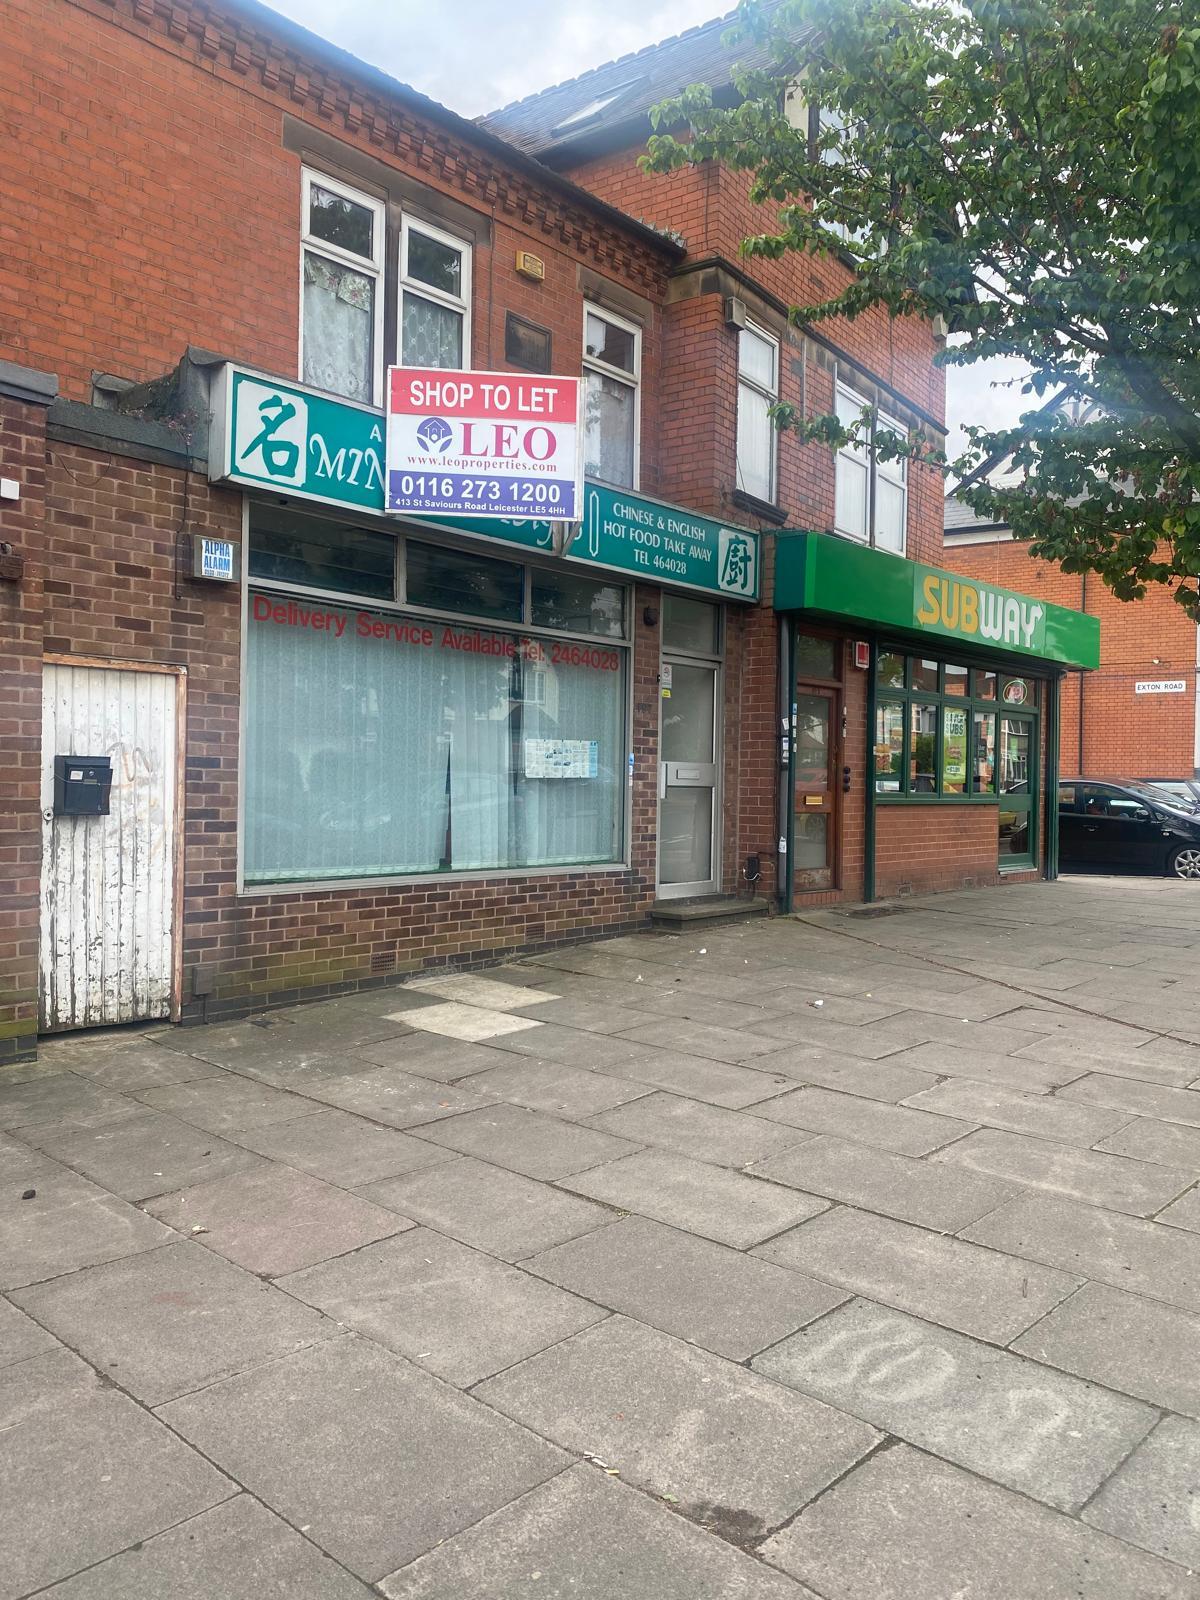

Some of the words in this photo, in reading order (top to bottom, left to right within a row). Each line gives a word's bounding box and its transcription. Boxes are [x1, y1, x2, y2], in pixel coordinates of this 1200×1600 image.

[409, 379, 474, 409] SHOP
[480, 384, 511, 411] TO
[518, 386, 558, 413] LET
[240, 394, 300, 478] 名
[458, 422, 557, 461] LEO
[407, 455, 557, 473] www.leoproperties.com
[401, 475, 454, 497] 0116
[461, 479, 501, 500] 273
[509, 482, 561, 503] 1200
[395, 498, 411, 507] 413
[413, 498, 423, 507] St
[424, 499, 462, 510] Saviours
[464, 501, 487, 511] Road
[489, 503, 528, 513] Leicester
[530, 505, 546, 514] LE5
[548, 506, 566, 515] 4HH
[612, 502, 655, 527] CHINESE
[656, 516, 665, 530] &
[667, 519, 706, 542] ENGLISH
[204, 540, 230, 558] ALPHA
[603, 520, 627, 539] HOT
[629, 527, 661, 548] FOOD
[663, 537, 686, 555] TAKE
[688, 545, 712, 563] AWAY
[204, 555, 230, 571] ALARM
[633, 548, 650, 566] TEL
[653, 556, 687, 575] 464028
[916, 575, 1044, 648] SUBWAY
[253, 595, 347, 638] Delivery
[356, 611, 433, 646] Service
[441, 628, 516, 658] Available
[551, 644, 619, 672] 2464028
